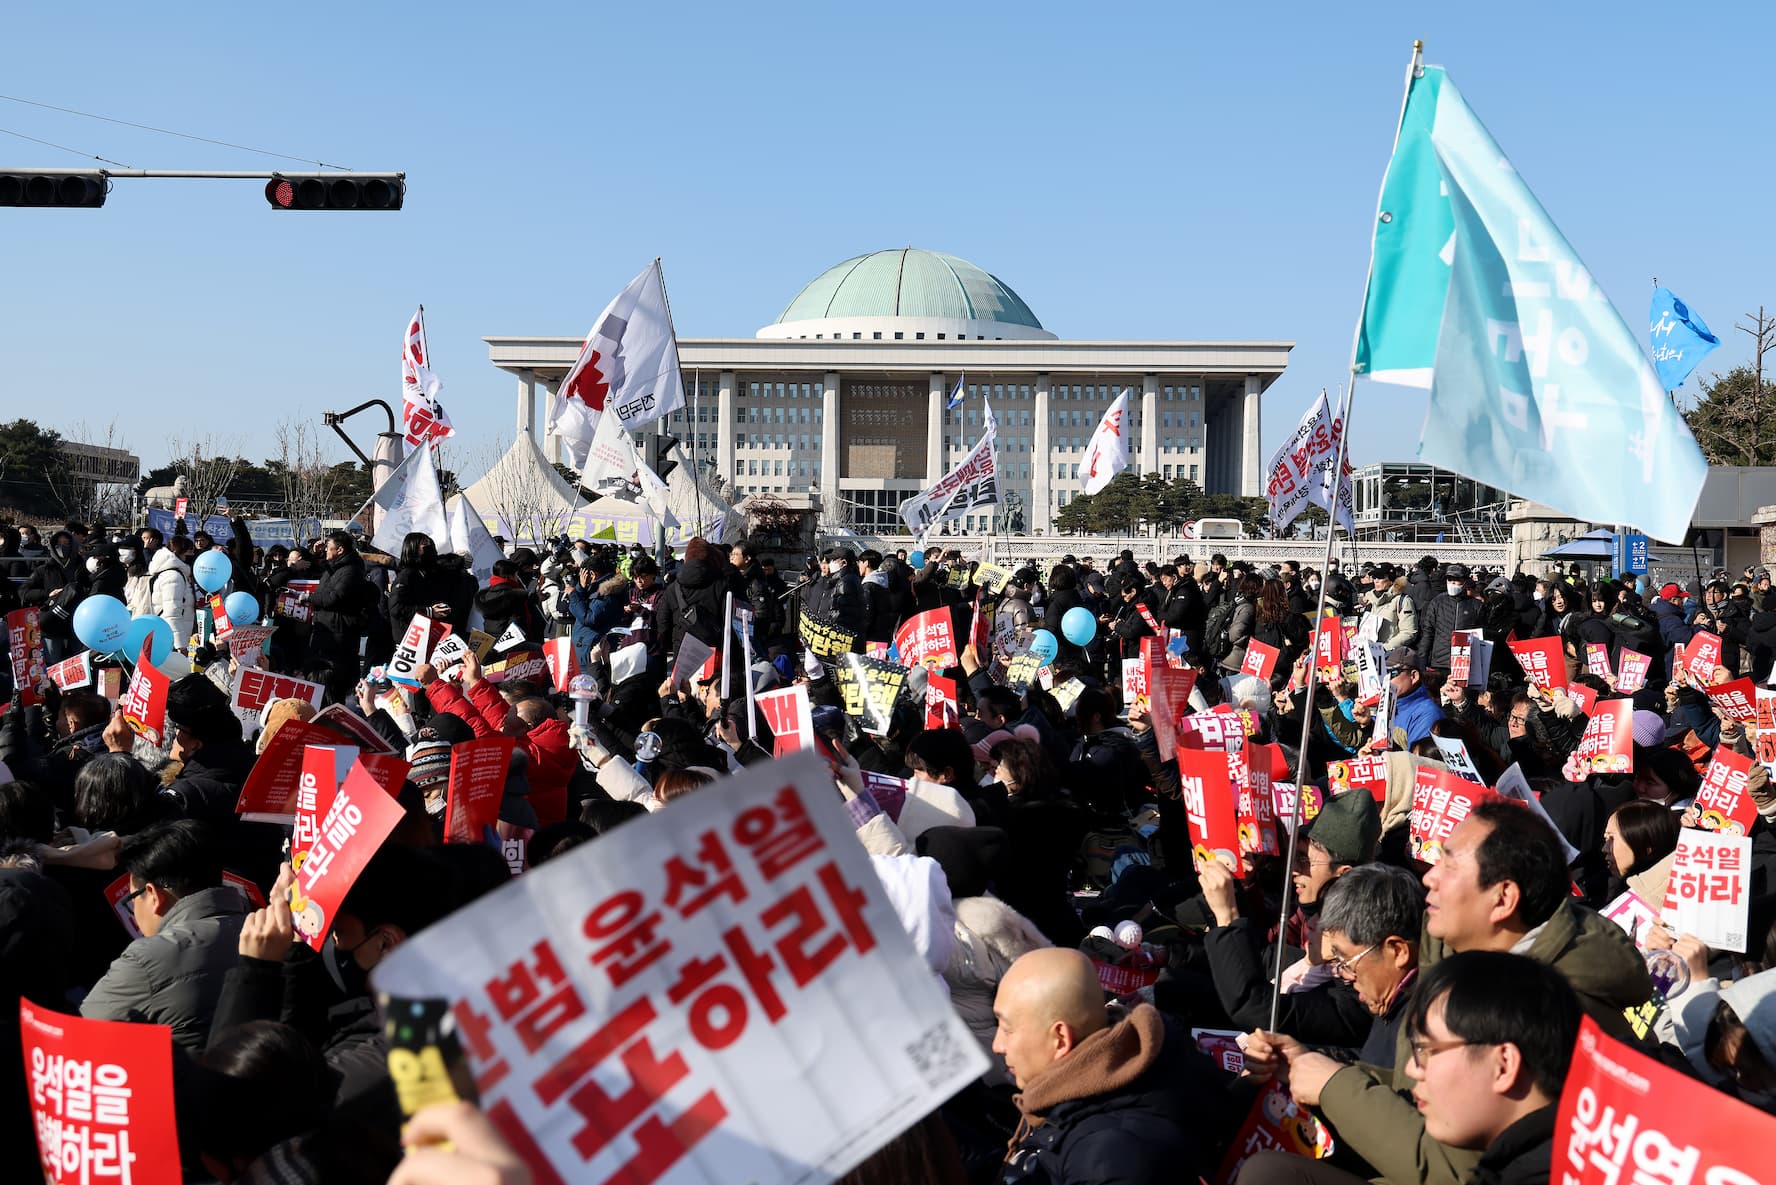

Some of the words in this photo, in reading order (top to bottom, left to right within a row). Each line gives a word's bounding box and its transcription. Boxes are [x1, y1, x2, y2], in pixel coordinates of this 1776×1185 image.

[1639, 541, 1646, 550] 2
[1639, 557, 1646, 565] 7
[1706, 760, 1749, 796] 열을
[1697, 779, 1739, 818] 하라
[1675, 843, 1743, 871] 윤석열
[582, 783, 829, 991] 윤석열
[32, 1046, 133, 1126] 윤석열을
